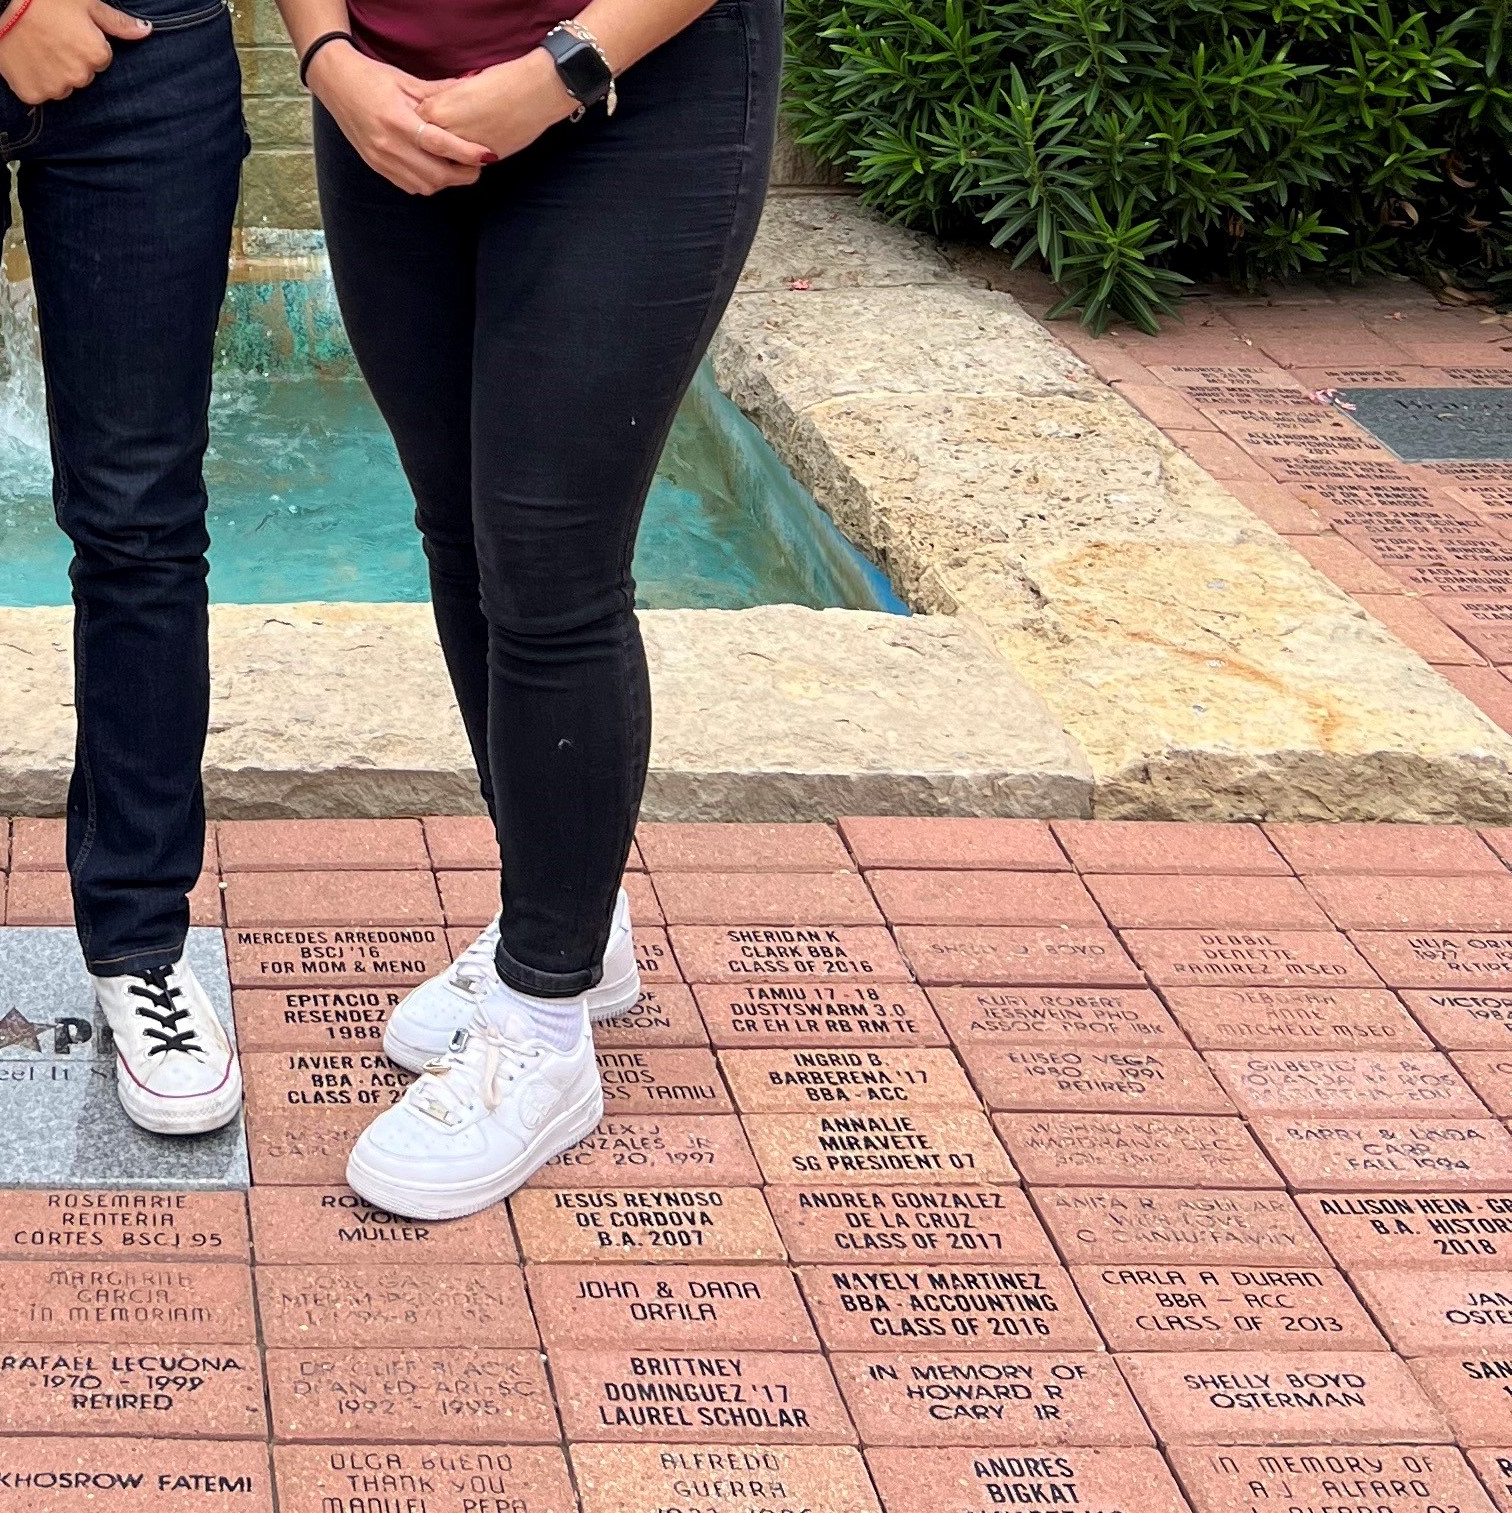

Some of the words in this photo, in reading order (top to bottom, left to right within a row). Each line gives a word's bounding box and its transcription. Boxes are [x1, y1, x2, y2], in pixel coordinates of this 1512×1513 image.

[238, 932, 327, 944] MERCEDES
[335, 931, 435, 943] ARREDONDO
[727, 931, 821, 942] SHERIDAN
[741, 946, 802, 958] CLARK
[807, 946, 847, 957] BBA
[261, 962, 294, 973] FOR
[302, 961, 346, 973] MOM
[355, 961, 366, 972] &
[373, 961, 425, 972] MENO
[728, 961, 789, 972] CLASS
[794, 961, 814, 972] OF
[823, 961, 873, 973] 2016
[822, 1117, 915, 1132] ANNALIE
[818, 1135, 932, 1151] MIRAVETE
[792, 1156, 821, 1171] SG
[826, 1154, 943, 1170] PRESIDENT
[949, 1154, 974, 1169] 07
[49, 1194, 186, 1208] ROSEMARIE
[555, 1193, 617, 1208] JESUS
[624, 1192, 722, 1207] REYNOSO
[799, 1193, 885, 1208] ANDREA
[892, 1193, 1006, 1208] GONZALEZ
[63, 1212, 173, 1226] RENTERIA
[576, 1212, 603, 1227] DE
[610, 1212, 713, 1227] CORDOVA
[845, 1213, 876, 1228] DE
[881, 1213, 910, 1228] LA
[915, 1213, 976, 1228] CRUZ
[15, 1231, 102, 1245] CORTES
[122, 1233, 179, 1248] BSCJ
[192, 1234, 221, 1246] 95
[835, 1233, 907, 1249] CLASS
[912, 1233, 938, 1249] OF
[946, 1233, 1001, 1249] 2017
[833, 1273, 919, 1290] NAYELY
[927, 1273, 1046, 1290] MARTINEZ
[1102, 1271, 1186, 1285] CARLA
[1199, 1272, 1219, 1285] A
[1231, 1272, 1323, 1286] DURAN
[870, 1318, 946, 1336] CLASS
[952, 1318, 978, 1335] OF
[987, 1318, 1050, 1335] 2016
[1136, 1316, 1222, 1330] CLASS
[1234, 1316, 1262, 1330] OF
[1281, 1317, 1343, 1331] 2013
[1, 1356, 98, 1371] RAFAEL
[112, 1357, 245, 1372] LECUONA
[631, 1357, 741, 1376] BRITTNEY
[1184, 1374, 1270, 1389] SHELLY
[1286, 1374, 1365, 1388] BOYD
[1210, 1393, 1365, 1408] OSTERMAN
[600, 1407, 693, 1426] LAUREL
[698, 1407, 810, 1427] SCHOLAR
[159, 1475, 251, 1492] FATEMI
